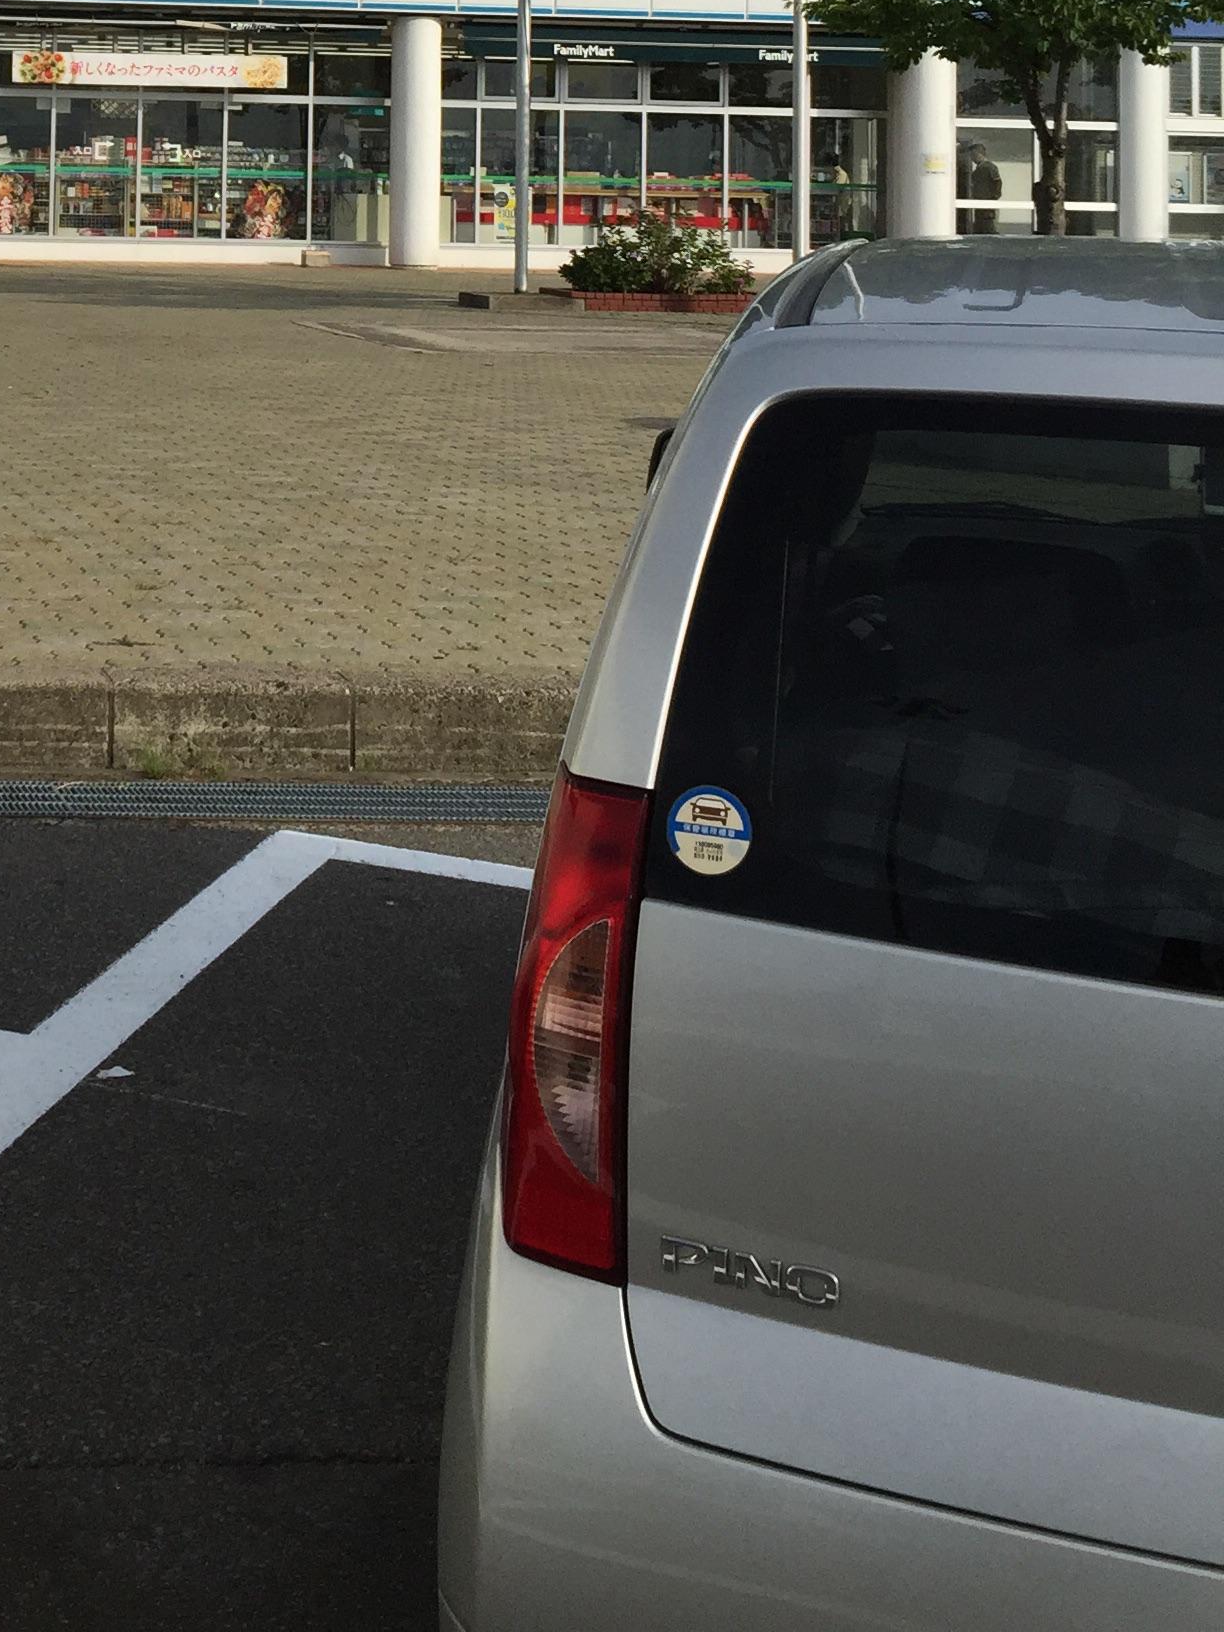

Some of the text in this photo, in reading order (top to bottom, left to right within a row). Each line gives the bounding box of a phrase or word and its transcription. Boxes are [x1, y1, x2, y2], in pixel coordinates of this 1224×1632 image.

[553, 44, 615, 58] FamilyMart
[758, 49, 819, 64] Familyrt
[69, 60, 239, 77] 新しくなったファミマのパスタ
[73, 145, 92, 156] 入口
[183, 148, 201, 159] 入口
[660, 1234, 840, 1306] PINO
